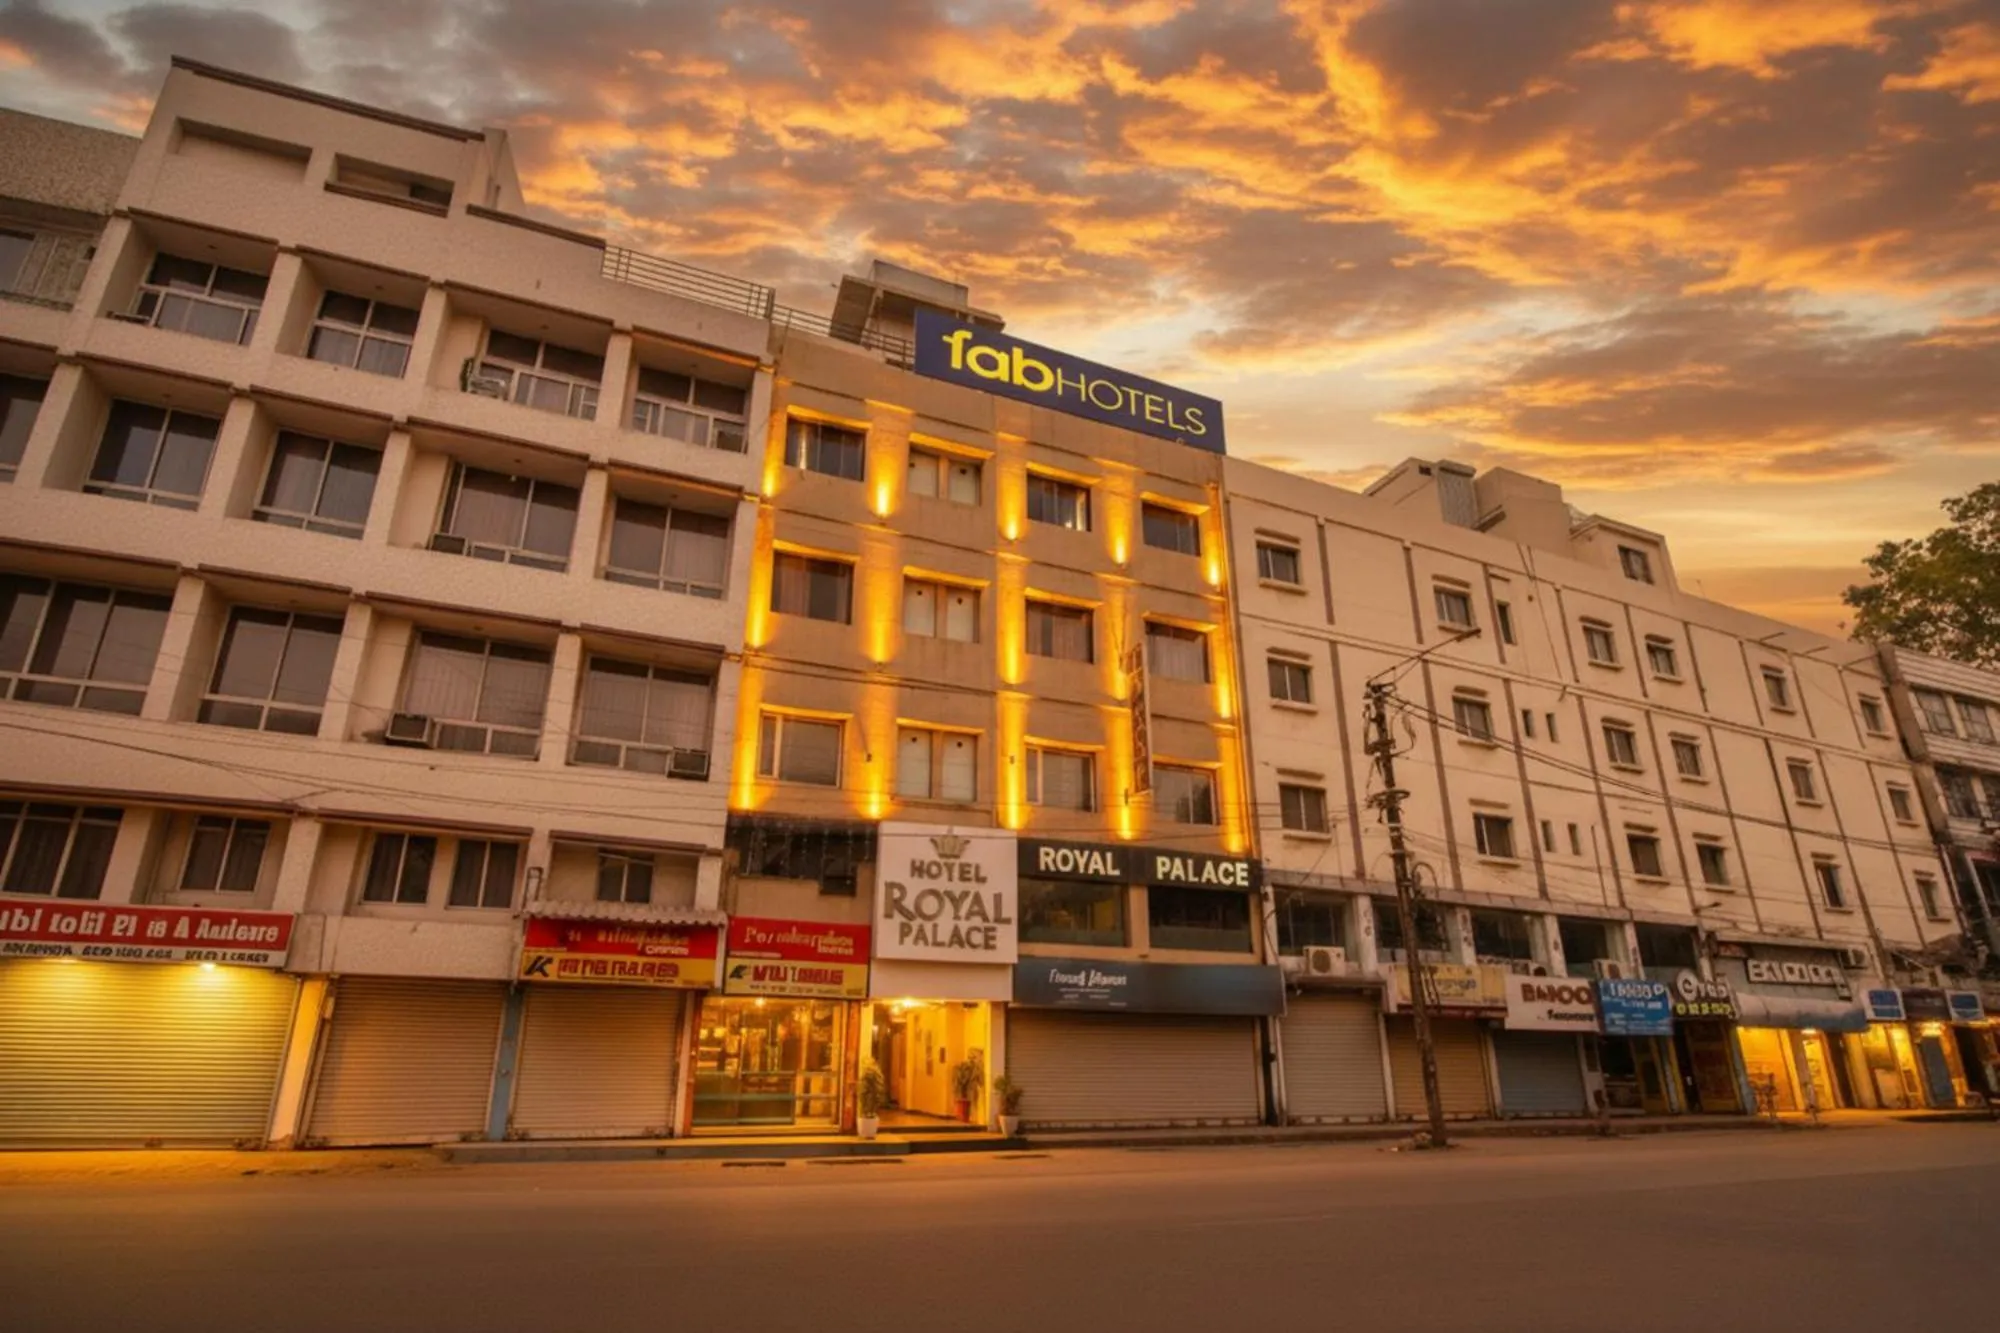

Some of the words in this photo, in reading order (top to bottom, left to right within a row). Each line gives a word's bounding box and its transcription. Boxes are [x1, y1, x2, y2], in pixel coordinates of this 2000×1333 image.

[942, 330, 1207, 436] fabHOTELS
[910, 858, 988, 884] HOTEL
[1039, 846, 1121, 876] ROYAL
[1156, 855, 1249, 887] PALACE
[883, 881, 1013, 925] ROYAL
[898, 921, 998, 951] PALACE
